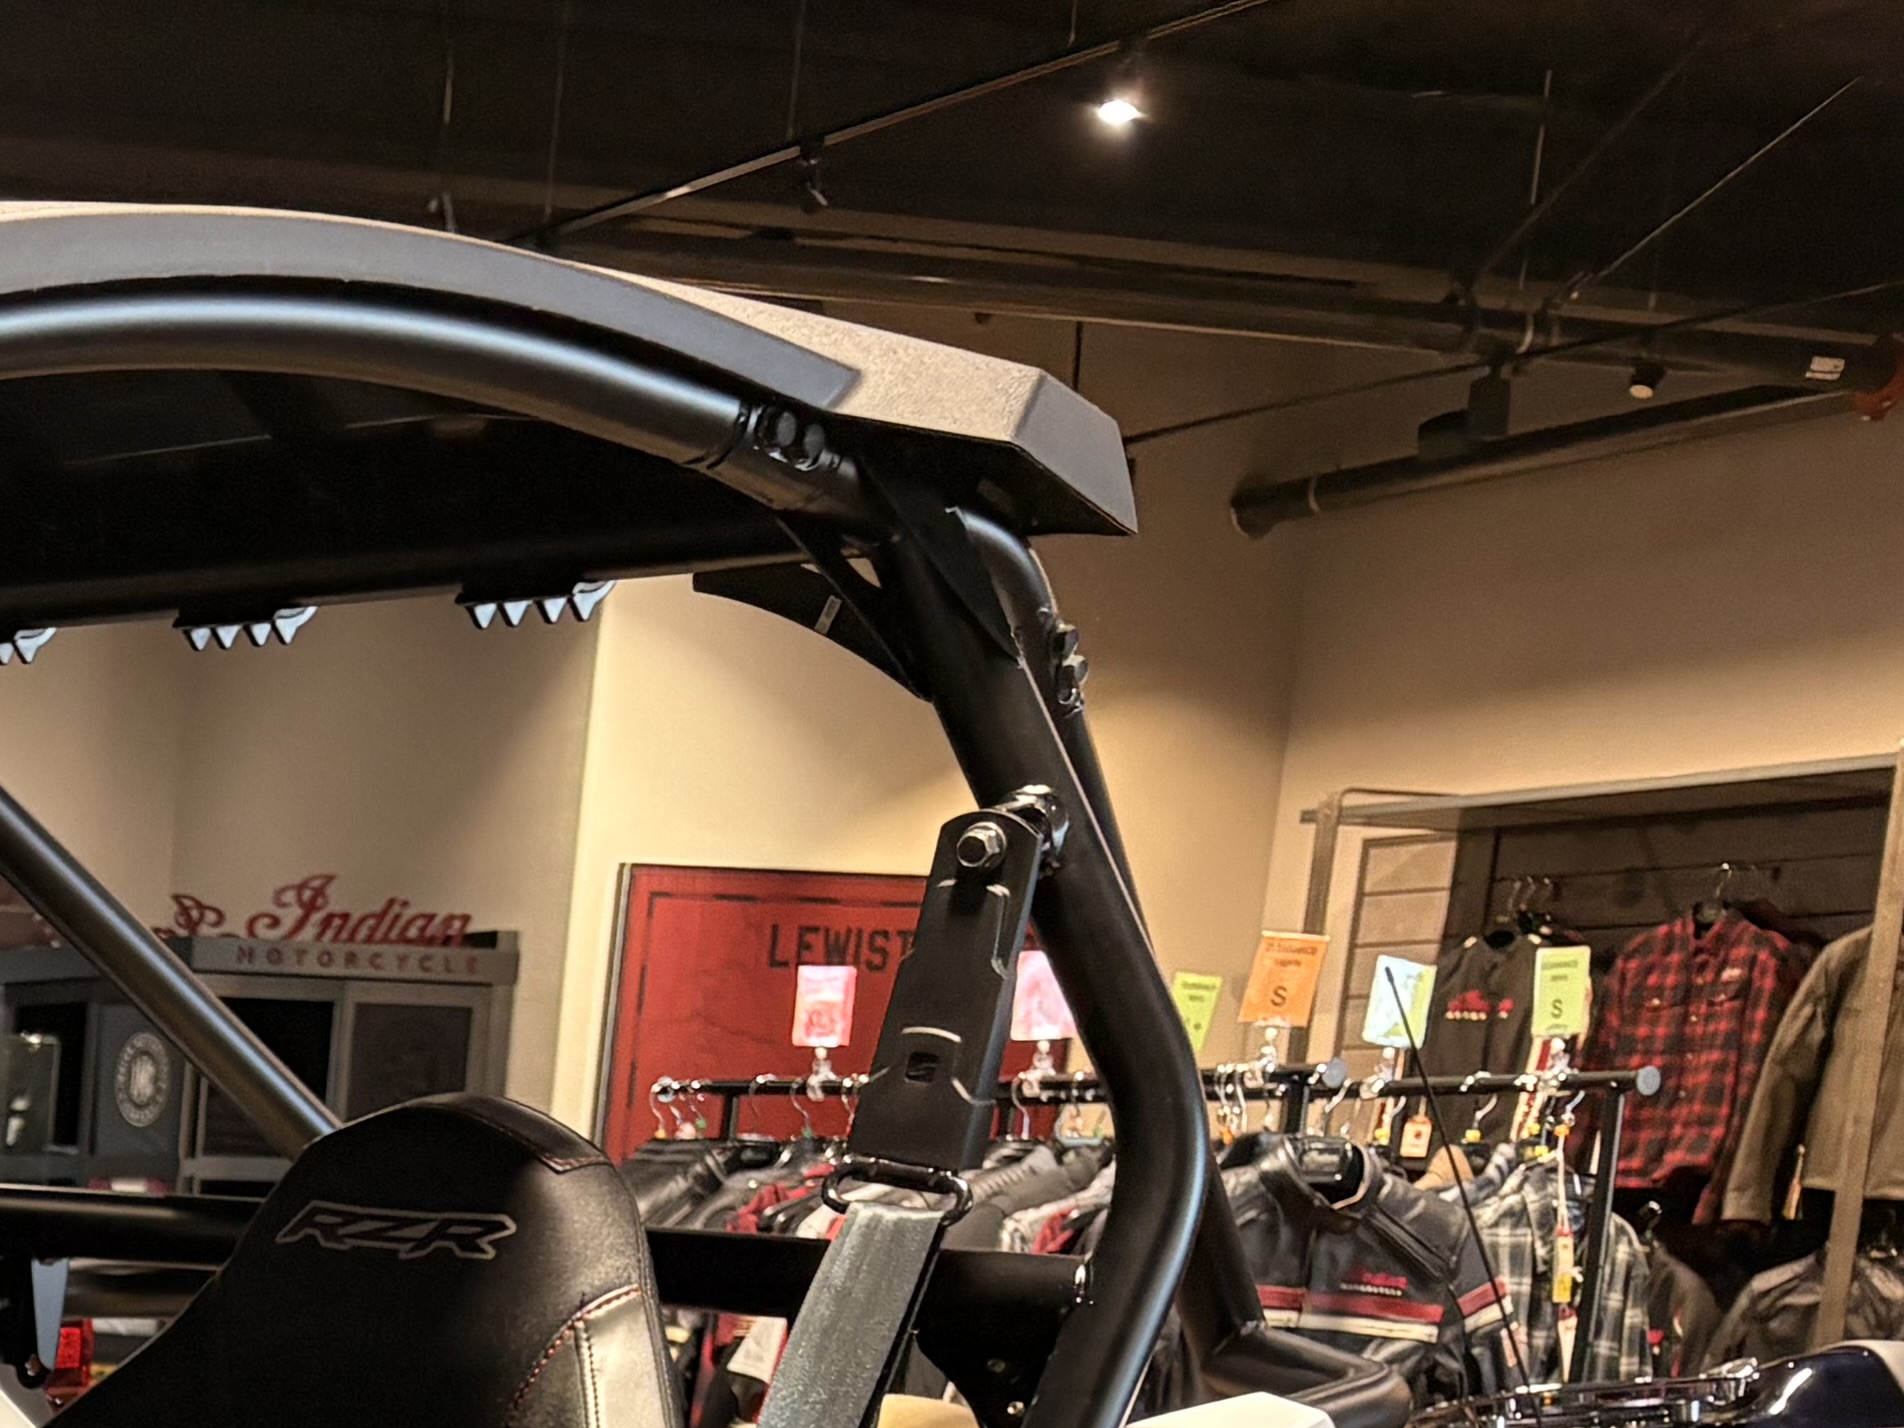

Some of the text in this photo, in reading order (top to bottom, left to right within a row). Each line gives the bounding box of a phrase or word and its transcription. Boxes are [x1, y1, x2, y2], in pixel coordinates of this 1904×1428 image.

[245, 874, 473, 947] Indian
[237, 946, 478, 974] MOTORCYCLE
[1270, 985, 1288, 1007] S
[1551, 998, 1563, 1018] S
[275, 1200, 517, 1260] RZR
